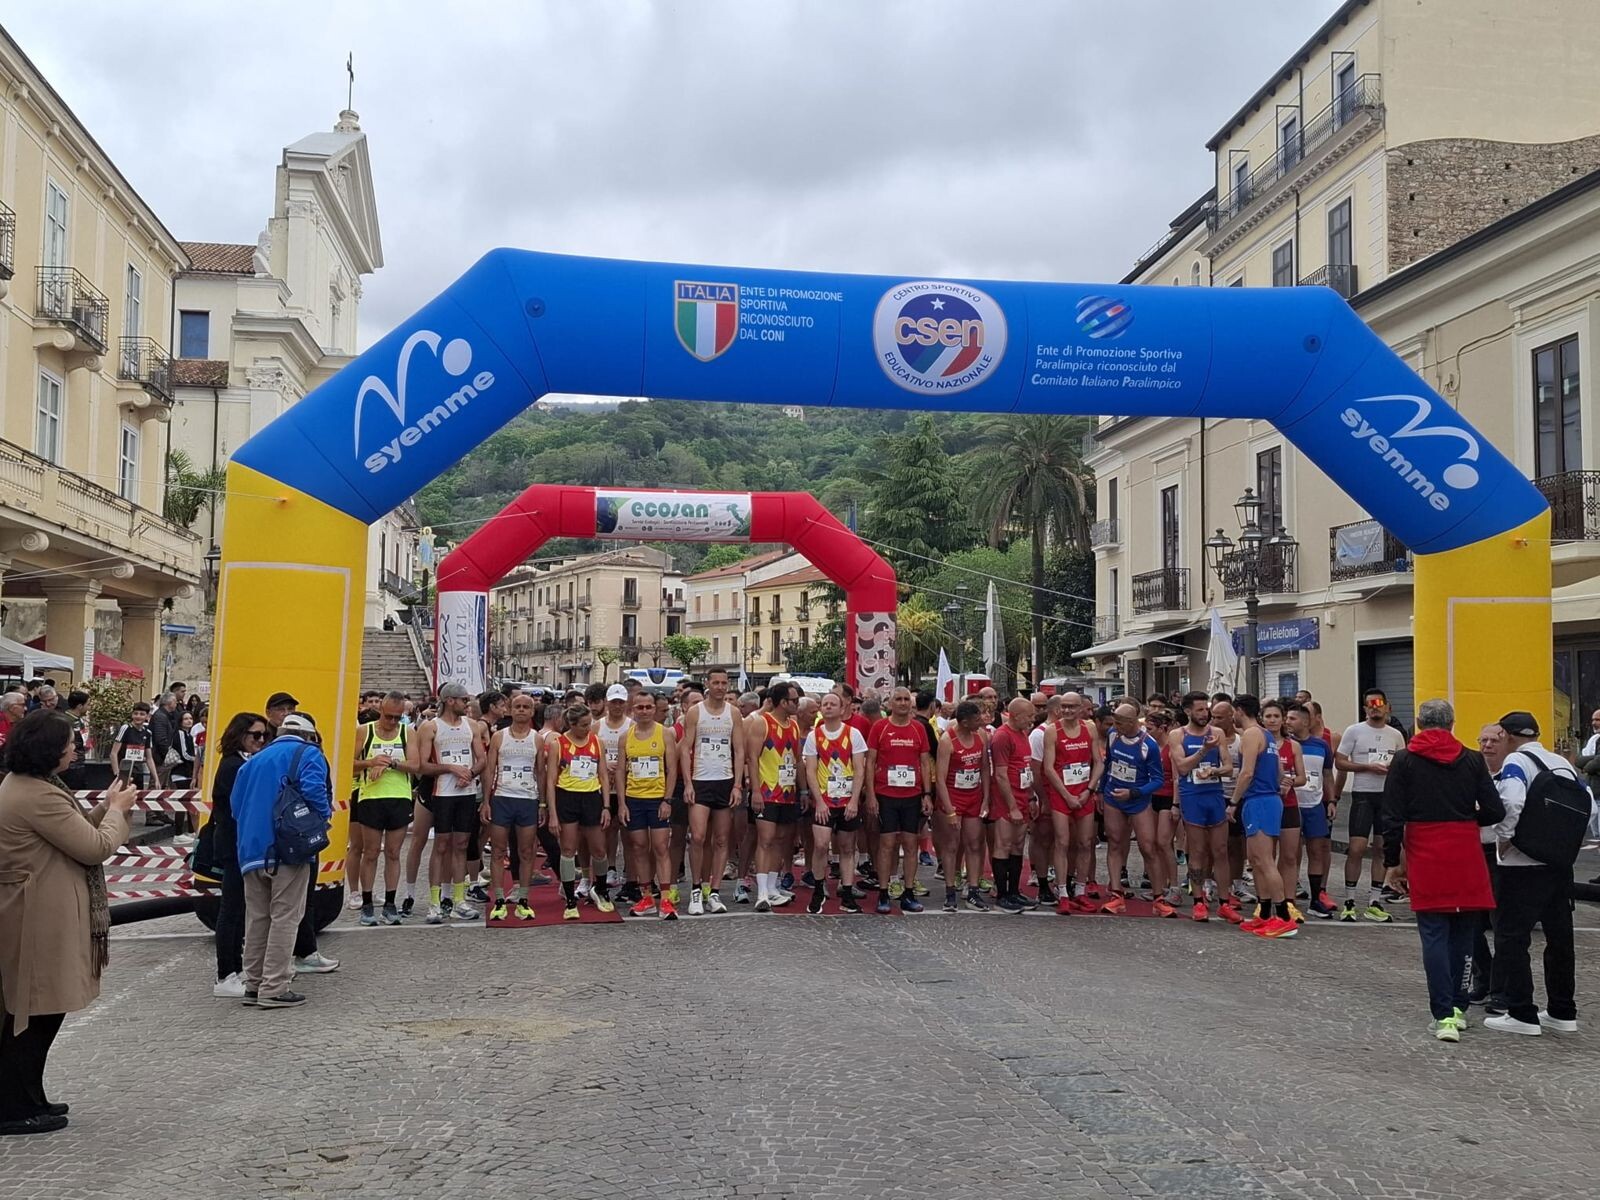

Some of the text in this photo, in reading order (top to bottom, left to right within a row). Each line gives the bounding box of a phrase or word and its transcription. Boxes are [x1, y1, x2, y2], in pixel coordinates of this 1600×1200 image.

[681, 284, 732, 300] ITALIA
[740, 286, 844, 302] ENTE DI PROMOZIONE
[893, 284, 981, 303] CENTRO SPORTIVO
[740, 299, 788, 312] SPORTIVA
[740, 313, 814, 328] RICONOSCIUTO
[740, 328, 785, 342] DAL CONI
[895, 316, 985, 348] csen
[1037, 345, 1183, 361] Ente di Promozione Sportiva
[884, 351, 993, 389] EDUCATIVO NAZIONALE
[1035, 359, 1177, 373] Paralimpica riconosciuto dal
[1031, 373, 1182, 390] Comitato Italiano Paralimpico
[364, 371, 495, 474] syemme
[1340, 407, 1450, 511] syemme
[631, 502, 709, 518] ecosan
[456, 615, 467, 686] SERVIZI
[1460, 954, 1473, 990] Joma
